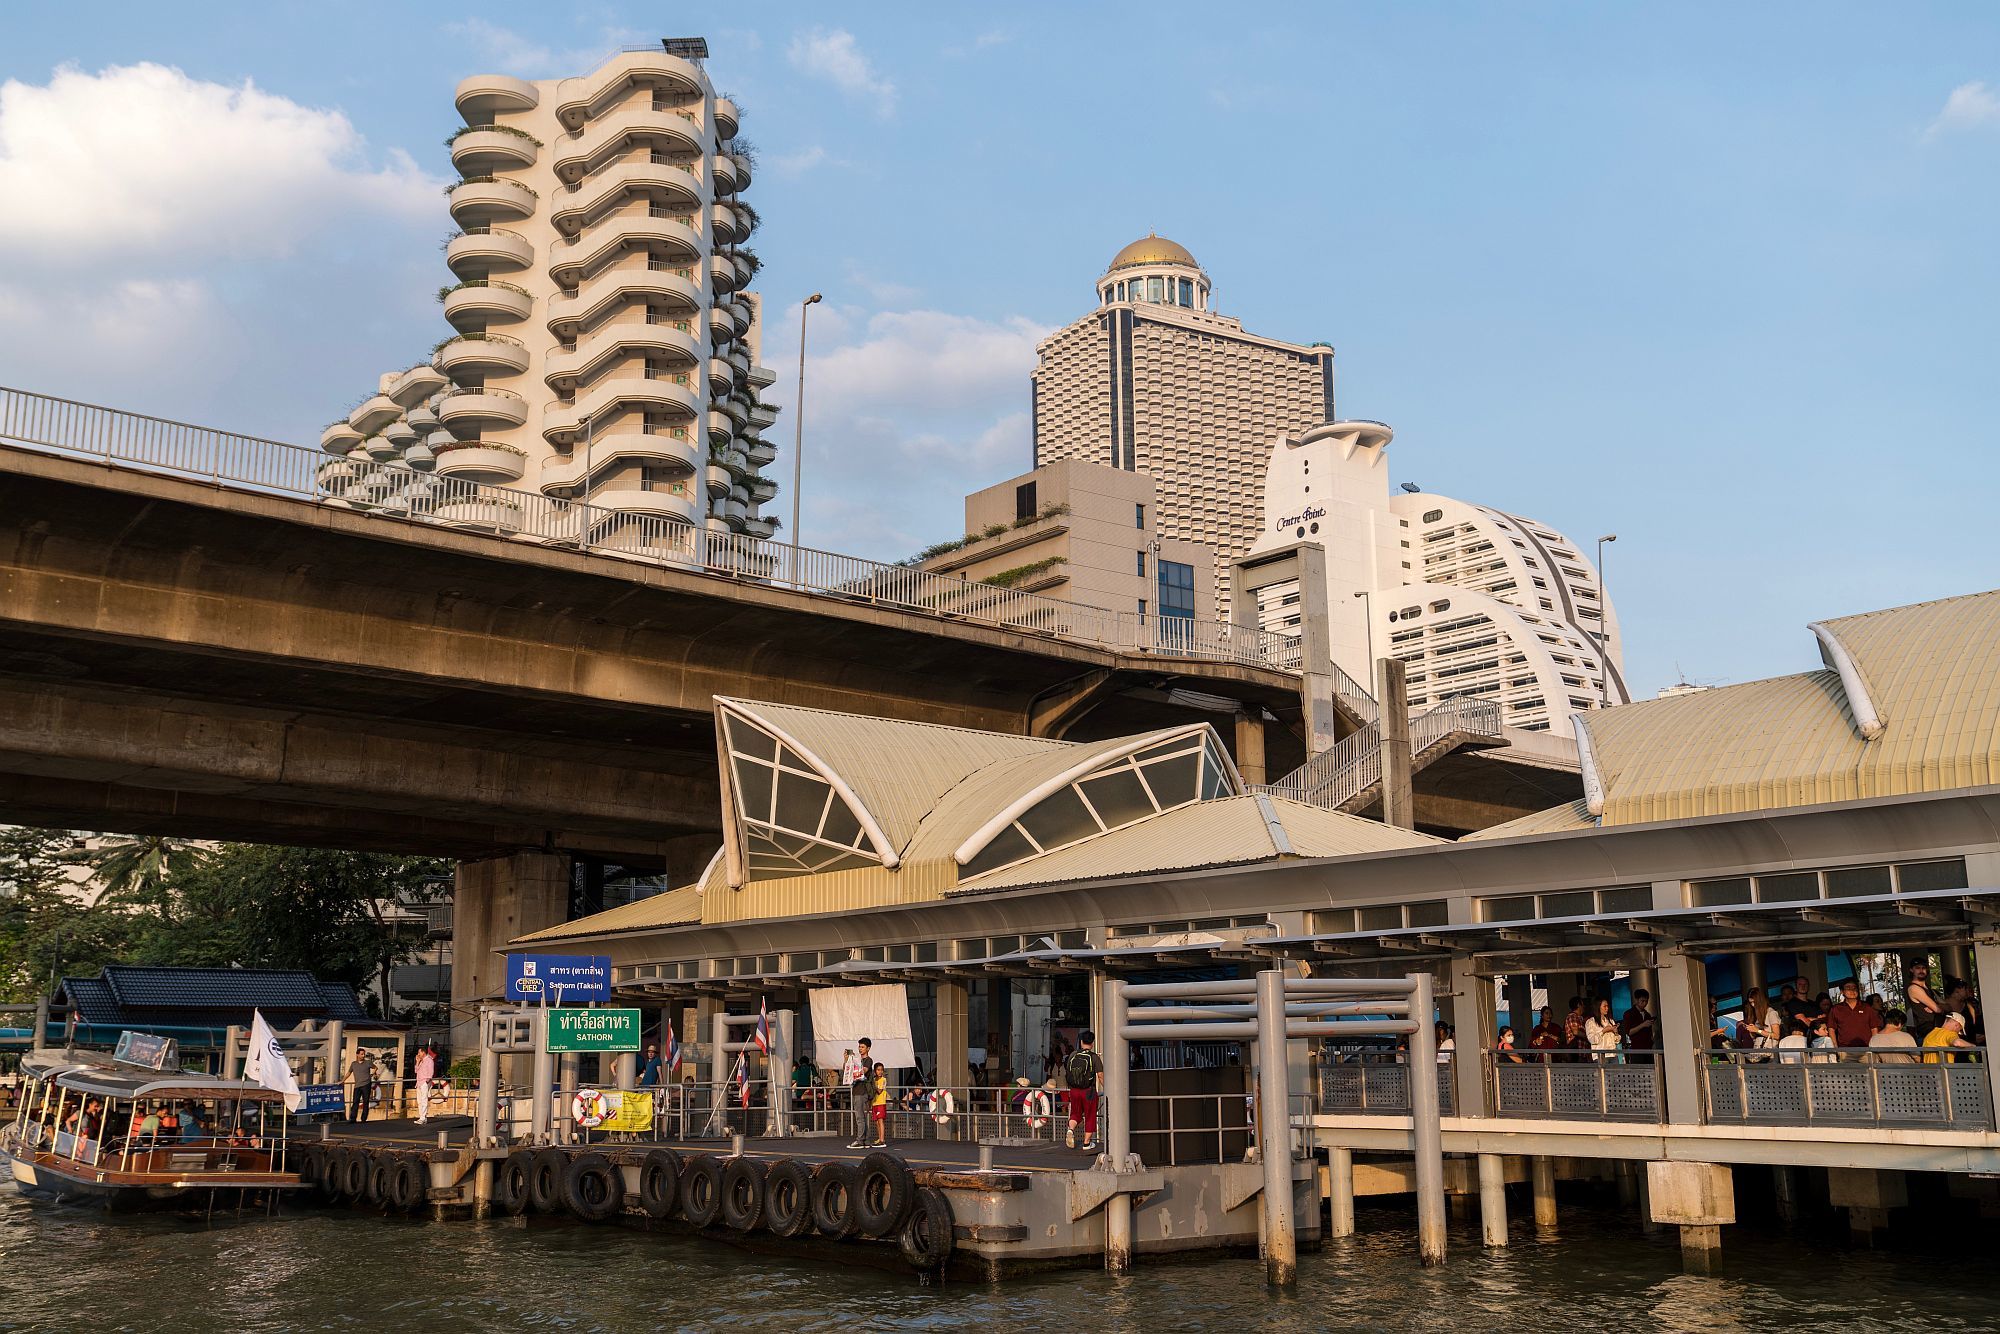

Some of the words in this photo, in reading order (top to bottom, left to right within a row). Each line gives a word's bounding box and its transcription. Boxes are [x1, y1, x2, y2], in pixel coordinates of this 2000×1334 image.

[1276, 515, 1301, 532] Centre
[1302, 506, 1327, 521] Point
[550, 966, 570, 975] สาทร
[522, 984, 538, 992] PIER
[549, 981, 576, 989] Sathorn
[576, 982, 603, 991] (Taksin)
[560, 1010, 630, 1030] ท่าเรือสาทร
[576, 1033, 613, 1041] SATHORN
